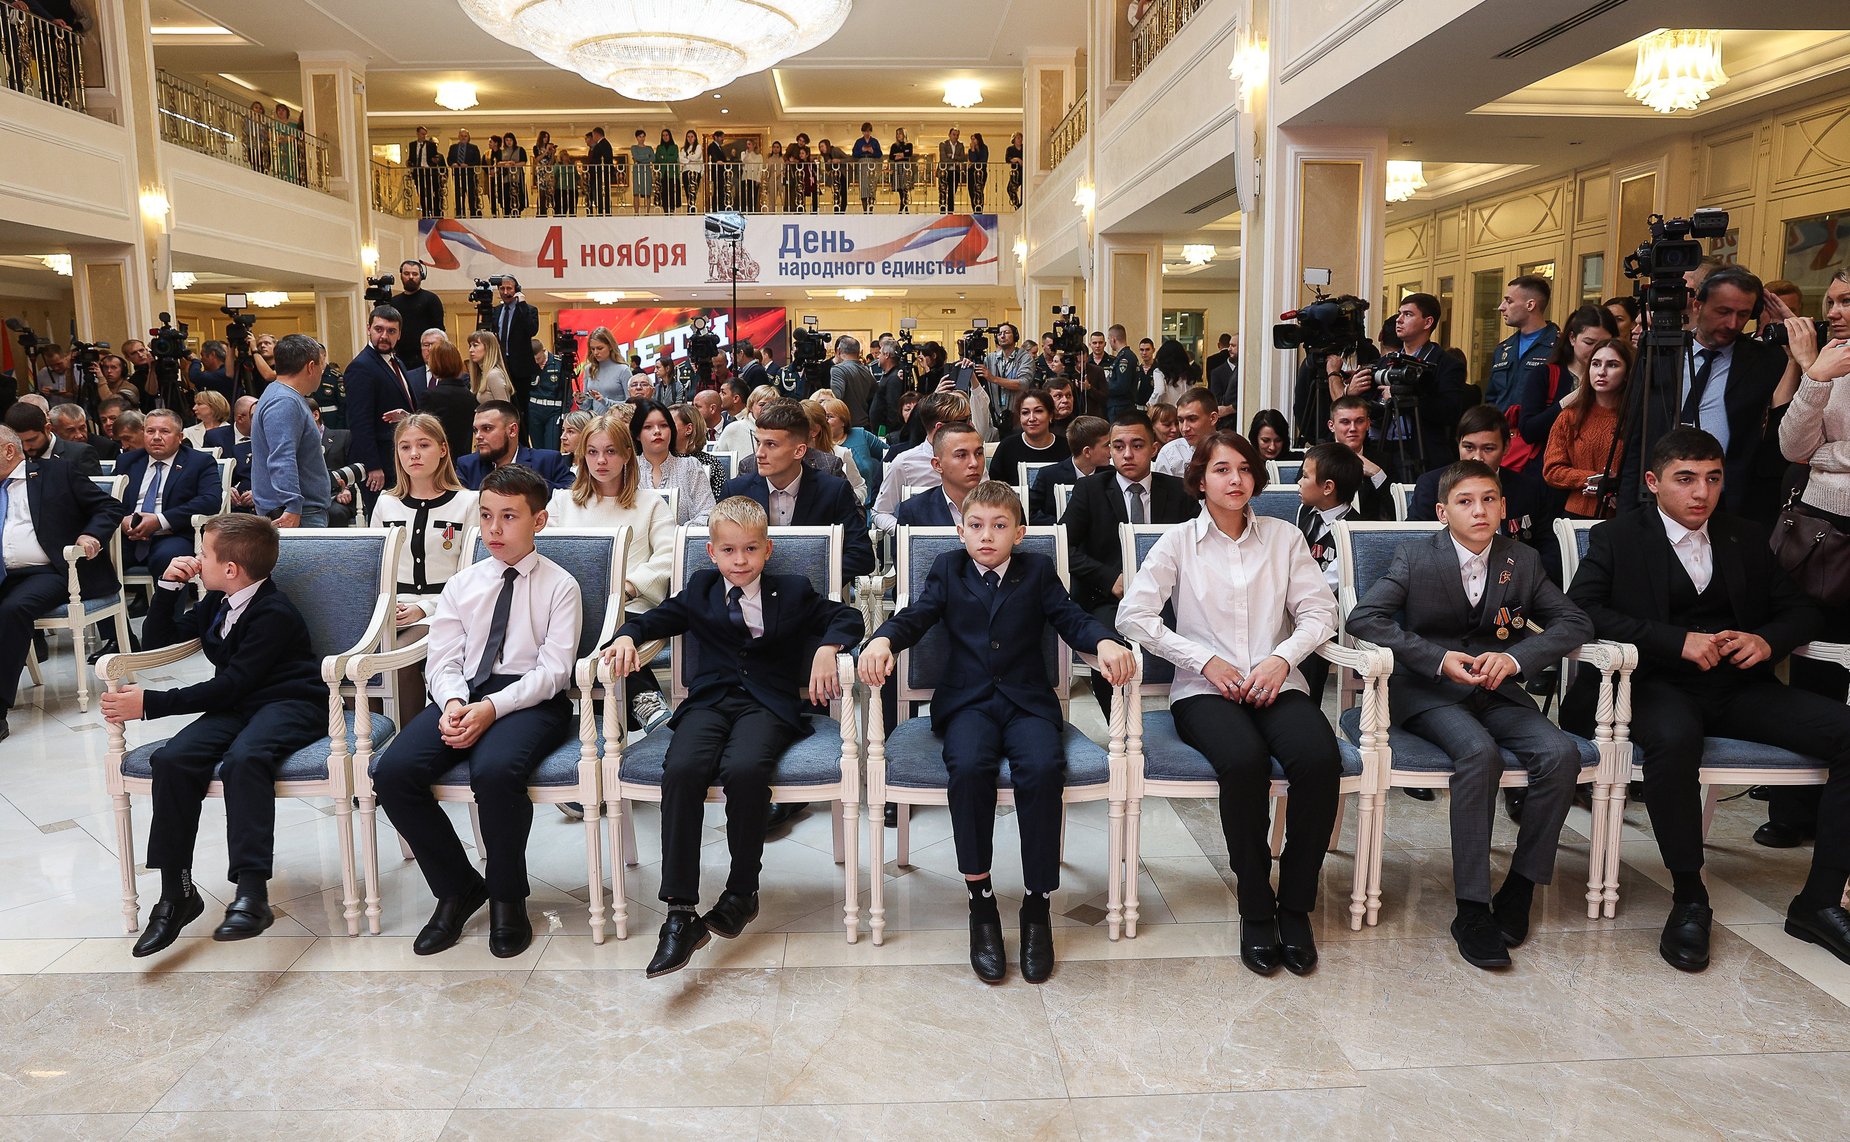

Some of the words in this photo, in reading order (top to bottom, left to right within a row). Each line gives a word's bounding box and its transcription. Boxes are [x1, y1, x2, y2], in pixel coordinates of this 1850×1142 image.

[537, 225, 568, 278] 4
[580, 236, 687, 273] ноября
[778, 224, 855, 259] День
[778, 261, 876, 279] народного
[881, 259, 966, 278] единства
